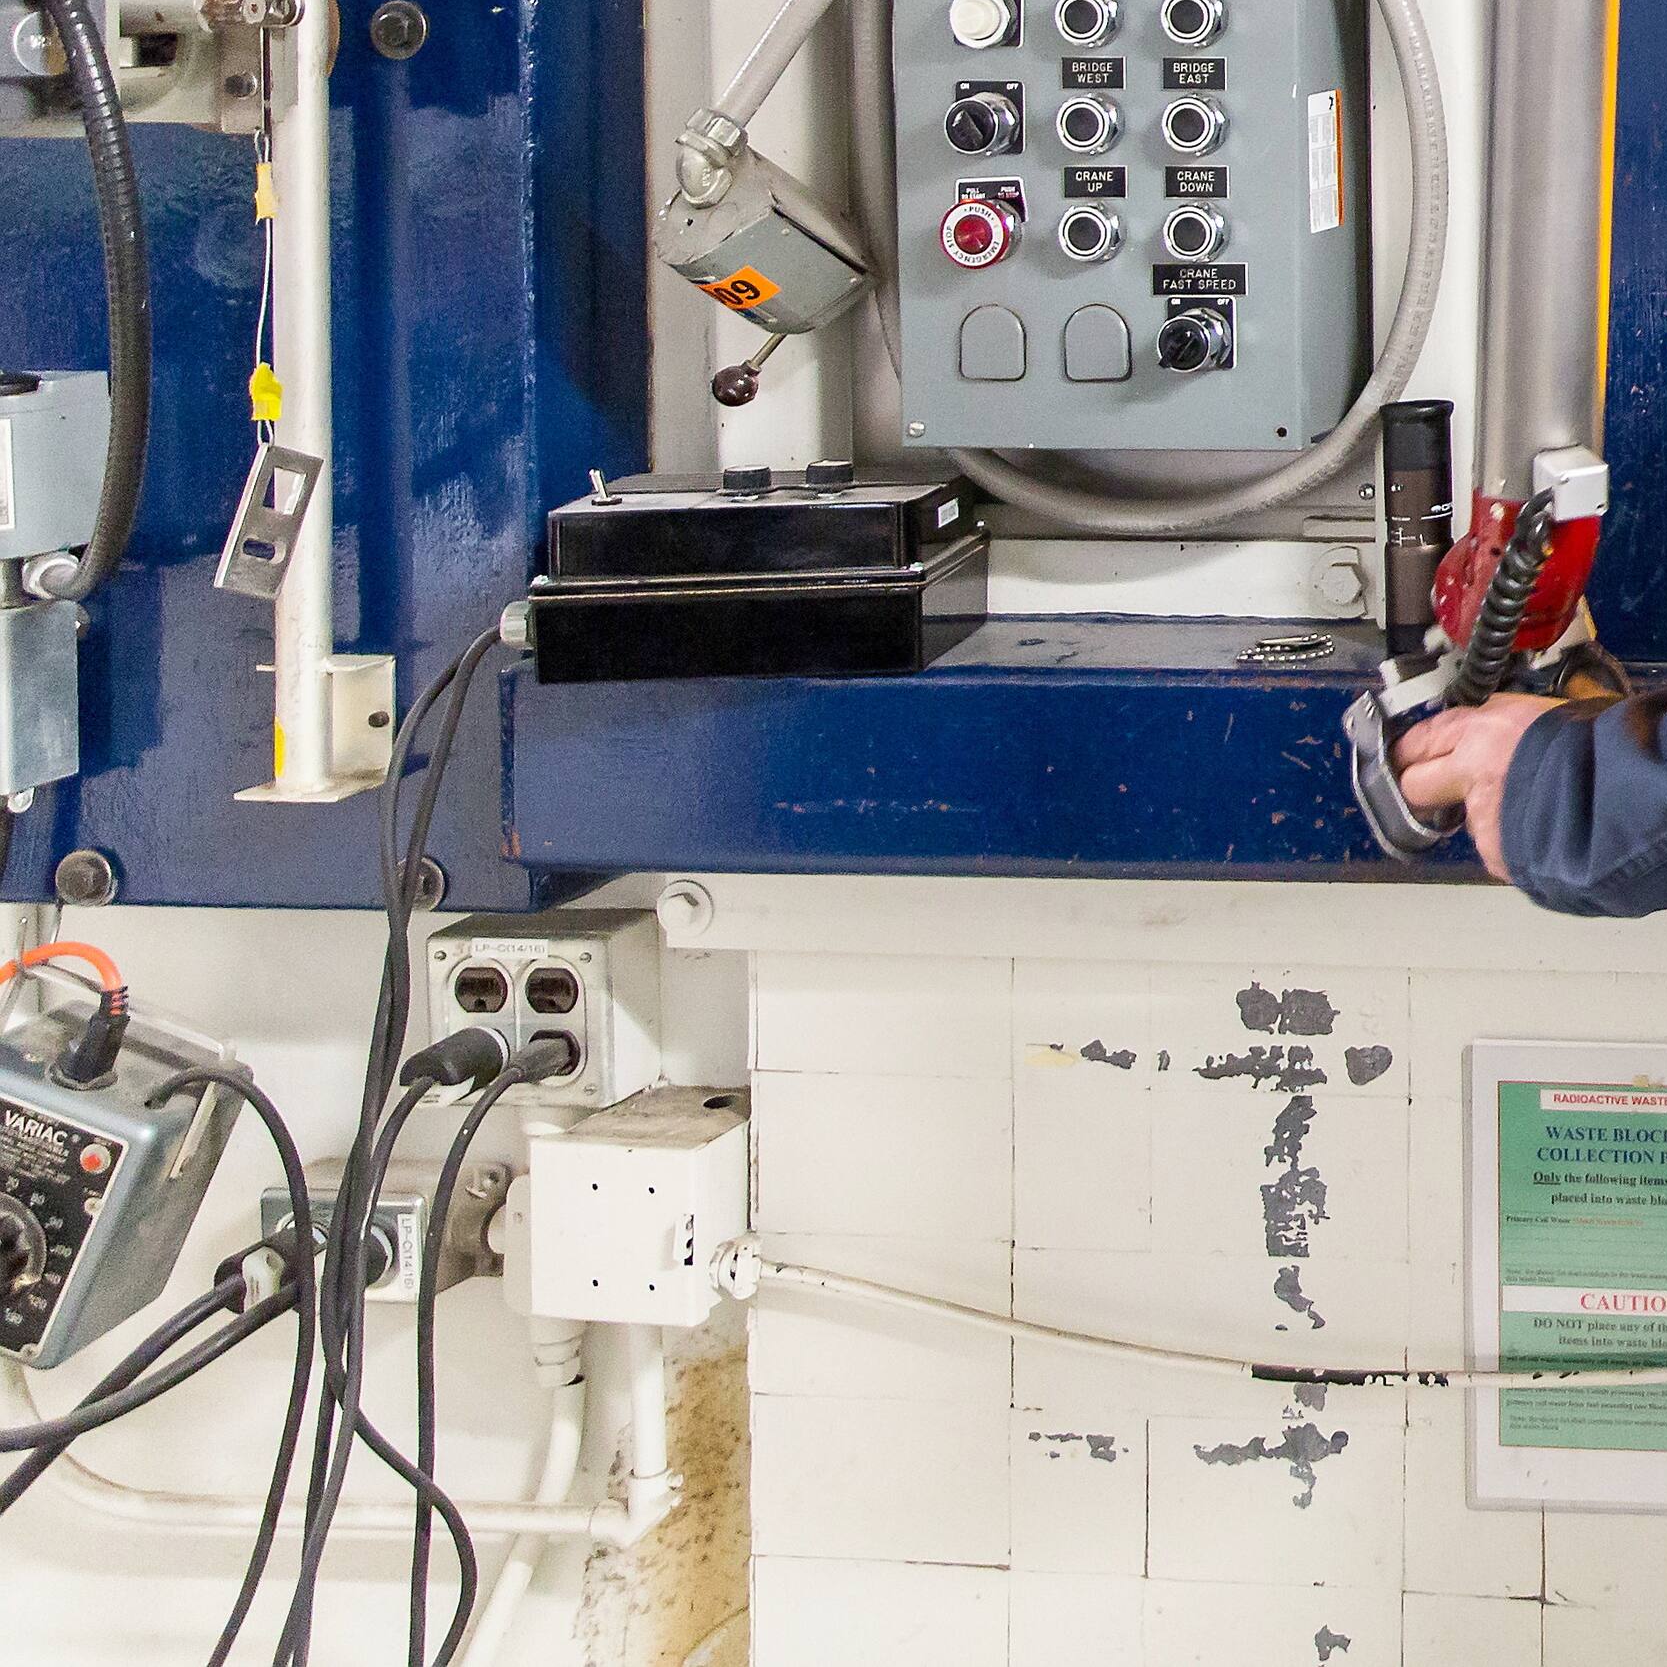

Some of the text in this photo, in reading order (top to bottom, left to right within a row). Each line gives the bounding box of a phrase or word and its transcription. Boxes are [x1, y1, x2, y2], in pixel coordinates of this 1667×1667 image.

[1072, 62, 1113, 73] BRIDGE
[1173, 62, 1215, 73] BRIDGE
[1077, 73, 1109, 84] WEST
[1179, 73, 1209, 84] EAST
[1075, 171, 1114, 181] CRANE
[1177, 171, 1215, 181] CRANE
[1087, 183, 1103, 192] UP
[1179, 183, 1213, 193] DOWN
[968, 206, 991, 218] PUSH
[1179, 268, 1218, 278] CRANE
[1163, 279, 1236, 290] FAST SPEED
[1553, 1093, 1629, 1106] RADIOACTIVE
[4, 1110, 68, 1145] VARIAC
[1546, 1126, 1608, 1142] WASTE
[1537, 1147, 1654, 1164] COLLECTION
[1533, 1172, 1562, 1186] Only
[1564, 1172, 1582, 1184] the
[1584, 1173, 1636, 1187] following
[1551, 1192, 1588, 1207] placed
[1590, 1194, 1613, 1204] into
[1615, 1196, 1647, 1206] waste
[1534, 1319, 1552, 1329] DO
[1557, 1319, 1583, 1330] NOT
[1588, 1321, 1616, 1334] place
[1619, 1323, 1639, 1335] any
[1643, 1322, 1656, 1334] of
[1558, 1336, 1588, 1347] items
[1591, 1337, 1614, 1348] into
[1617, 1339, 1648, 1349] waste
